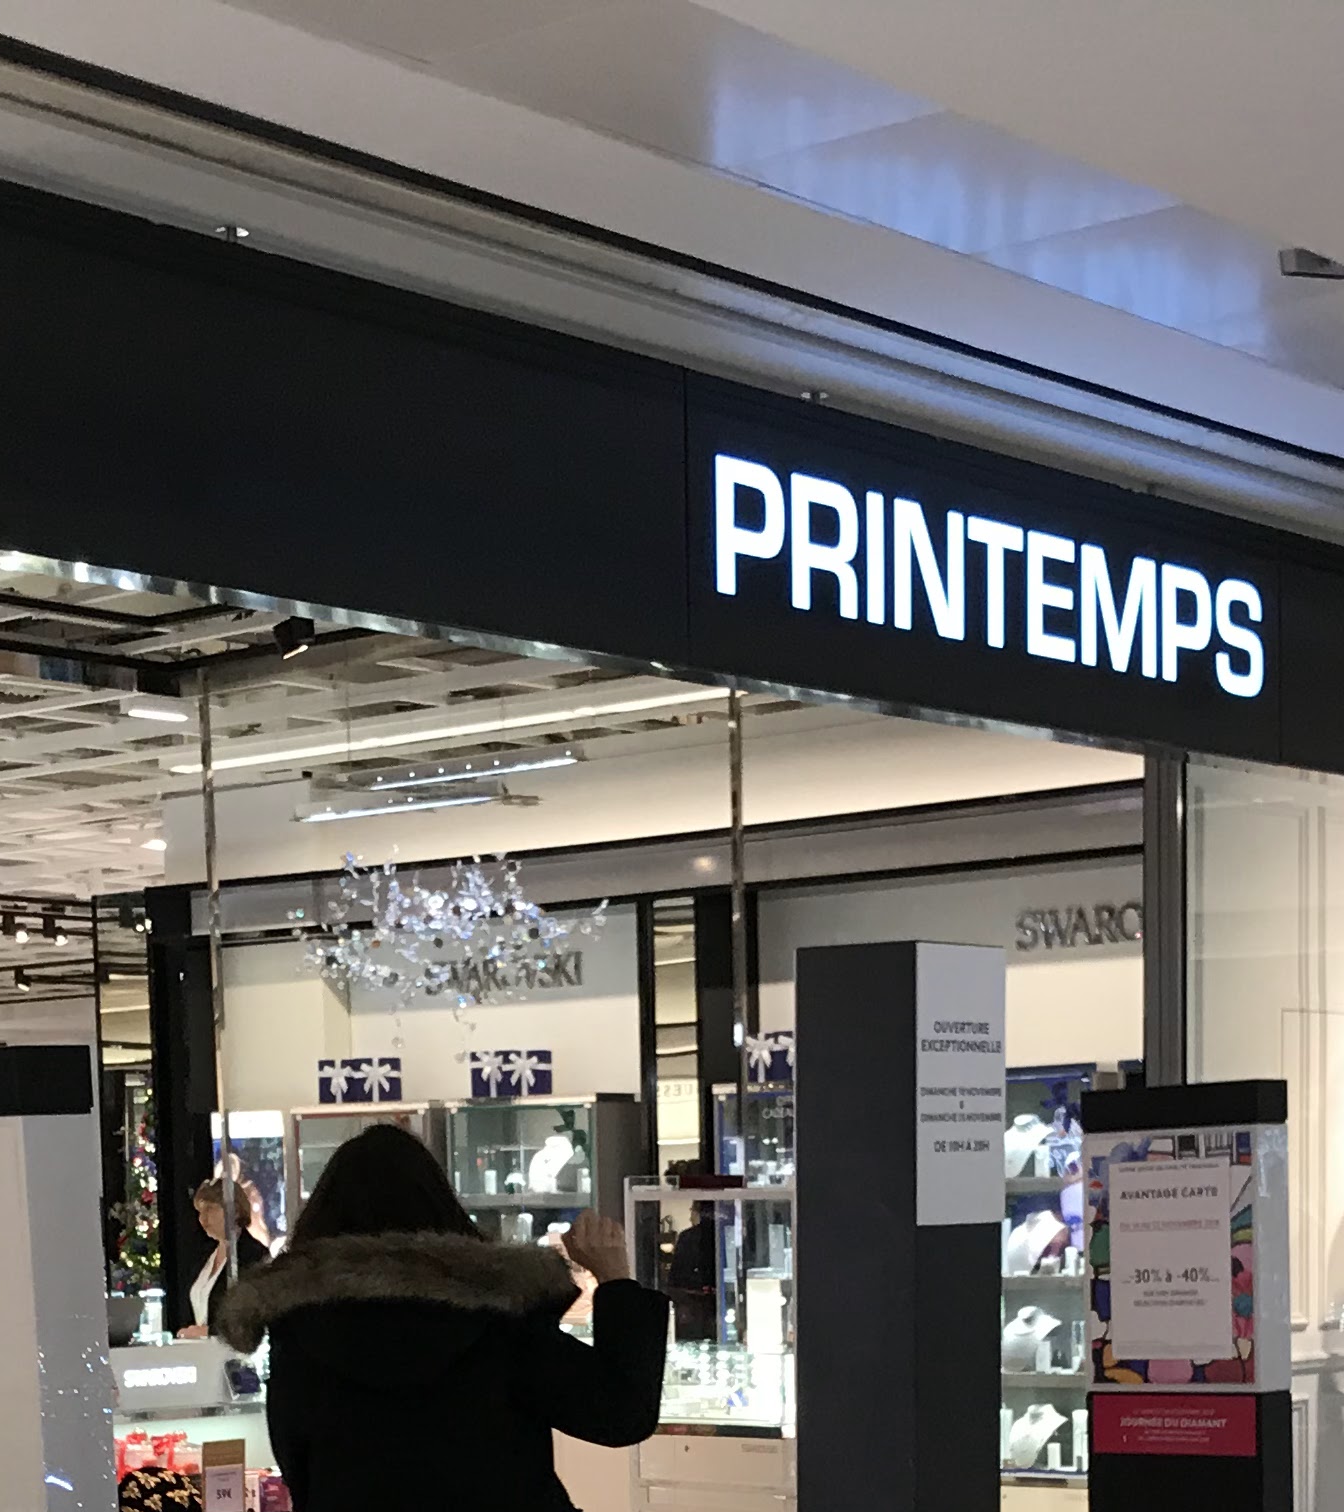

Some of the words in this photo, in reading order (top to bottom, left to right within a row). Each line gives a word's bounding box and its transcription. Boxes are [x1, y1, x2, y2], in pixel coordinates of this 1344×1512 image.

[713, 453, 1265, 698] PRINTEMPS
[424, 950, 583, 996] SWARSKI
[934, 1020, 989, 1034] OUVERTURE
[921, 1039, 1001, 1053] EXCEPTIONNELLE
[1120, 1188, 1177, 1200] AVANTAGE
[1181, 1185, 1218, 1198] CARTE
